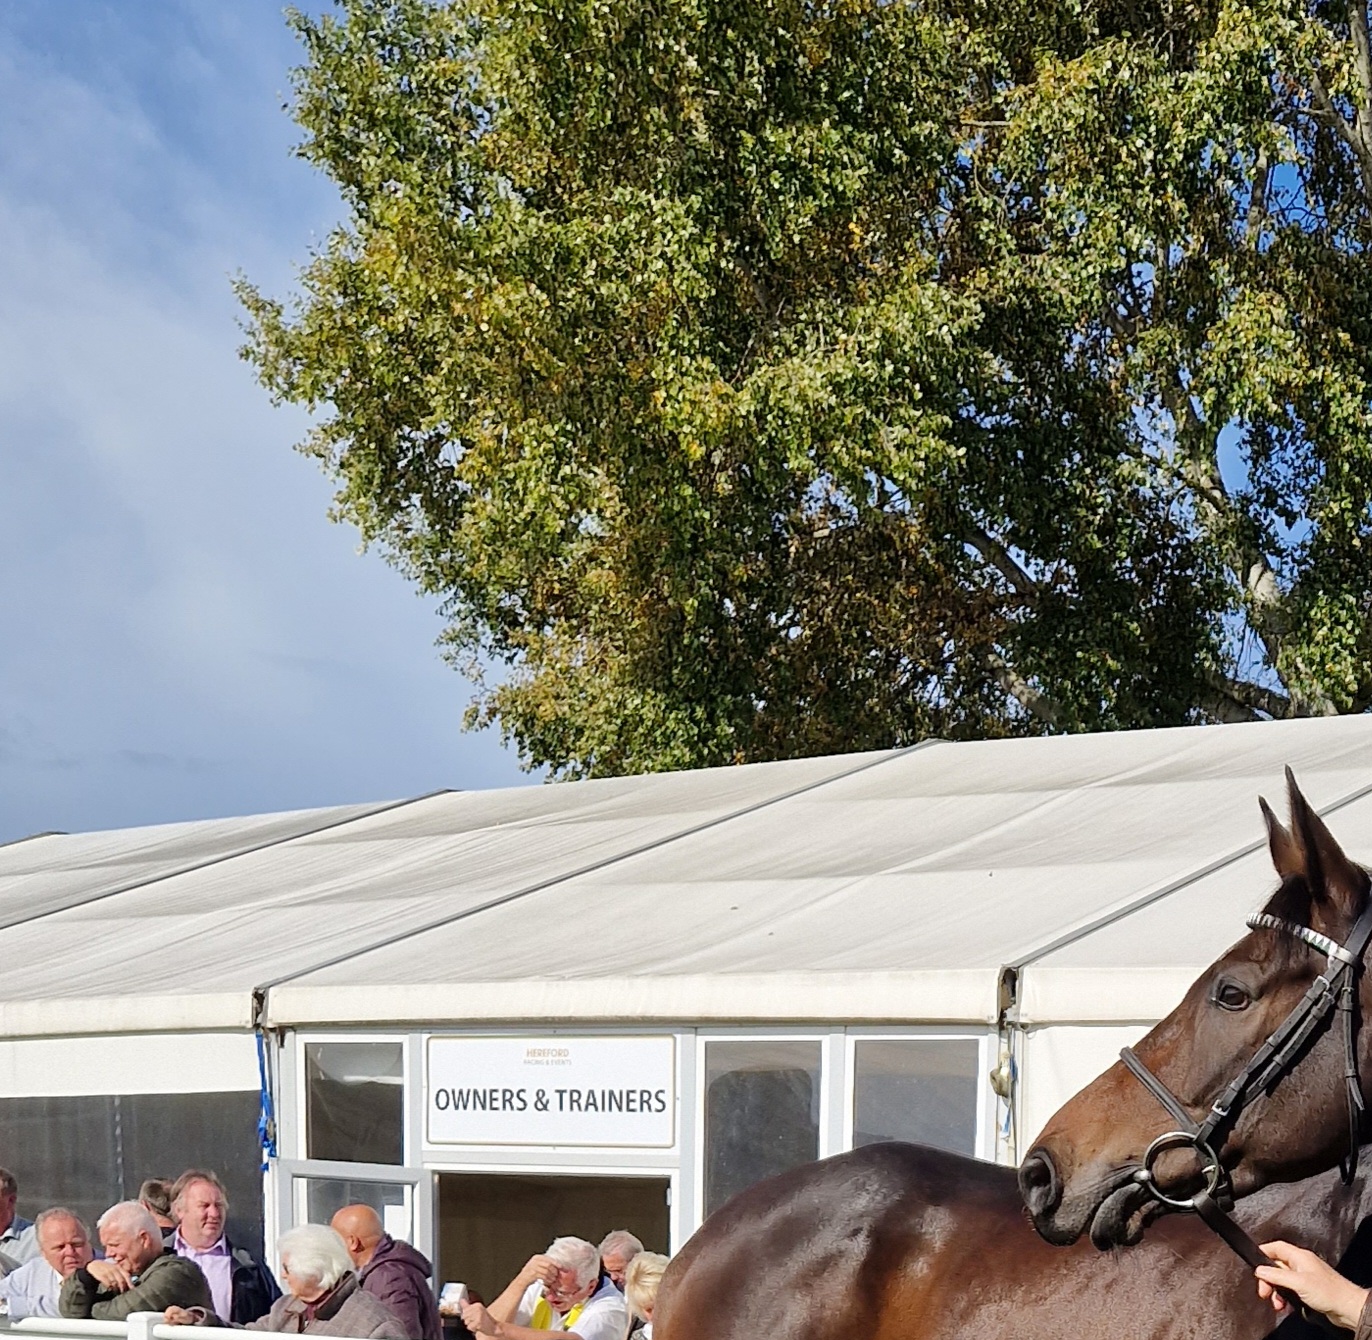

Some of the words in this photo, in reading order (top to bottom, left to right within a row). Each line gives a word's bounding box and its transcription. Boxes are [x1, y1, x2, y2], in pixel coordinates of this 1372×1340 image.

[526, 1048, 569, 1057] HEREFORD
[435, 1088, 527, 1111] OWNERS
[534, 1088, 550, 1112] &
[555, 1089, 666, 1112] TRAINERS
